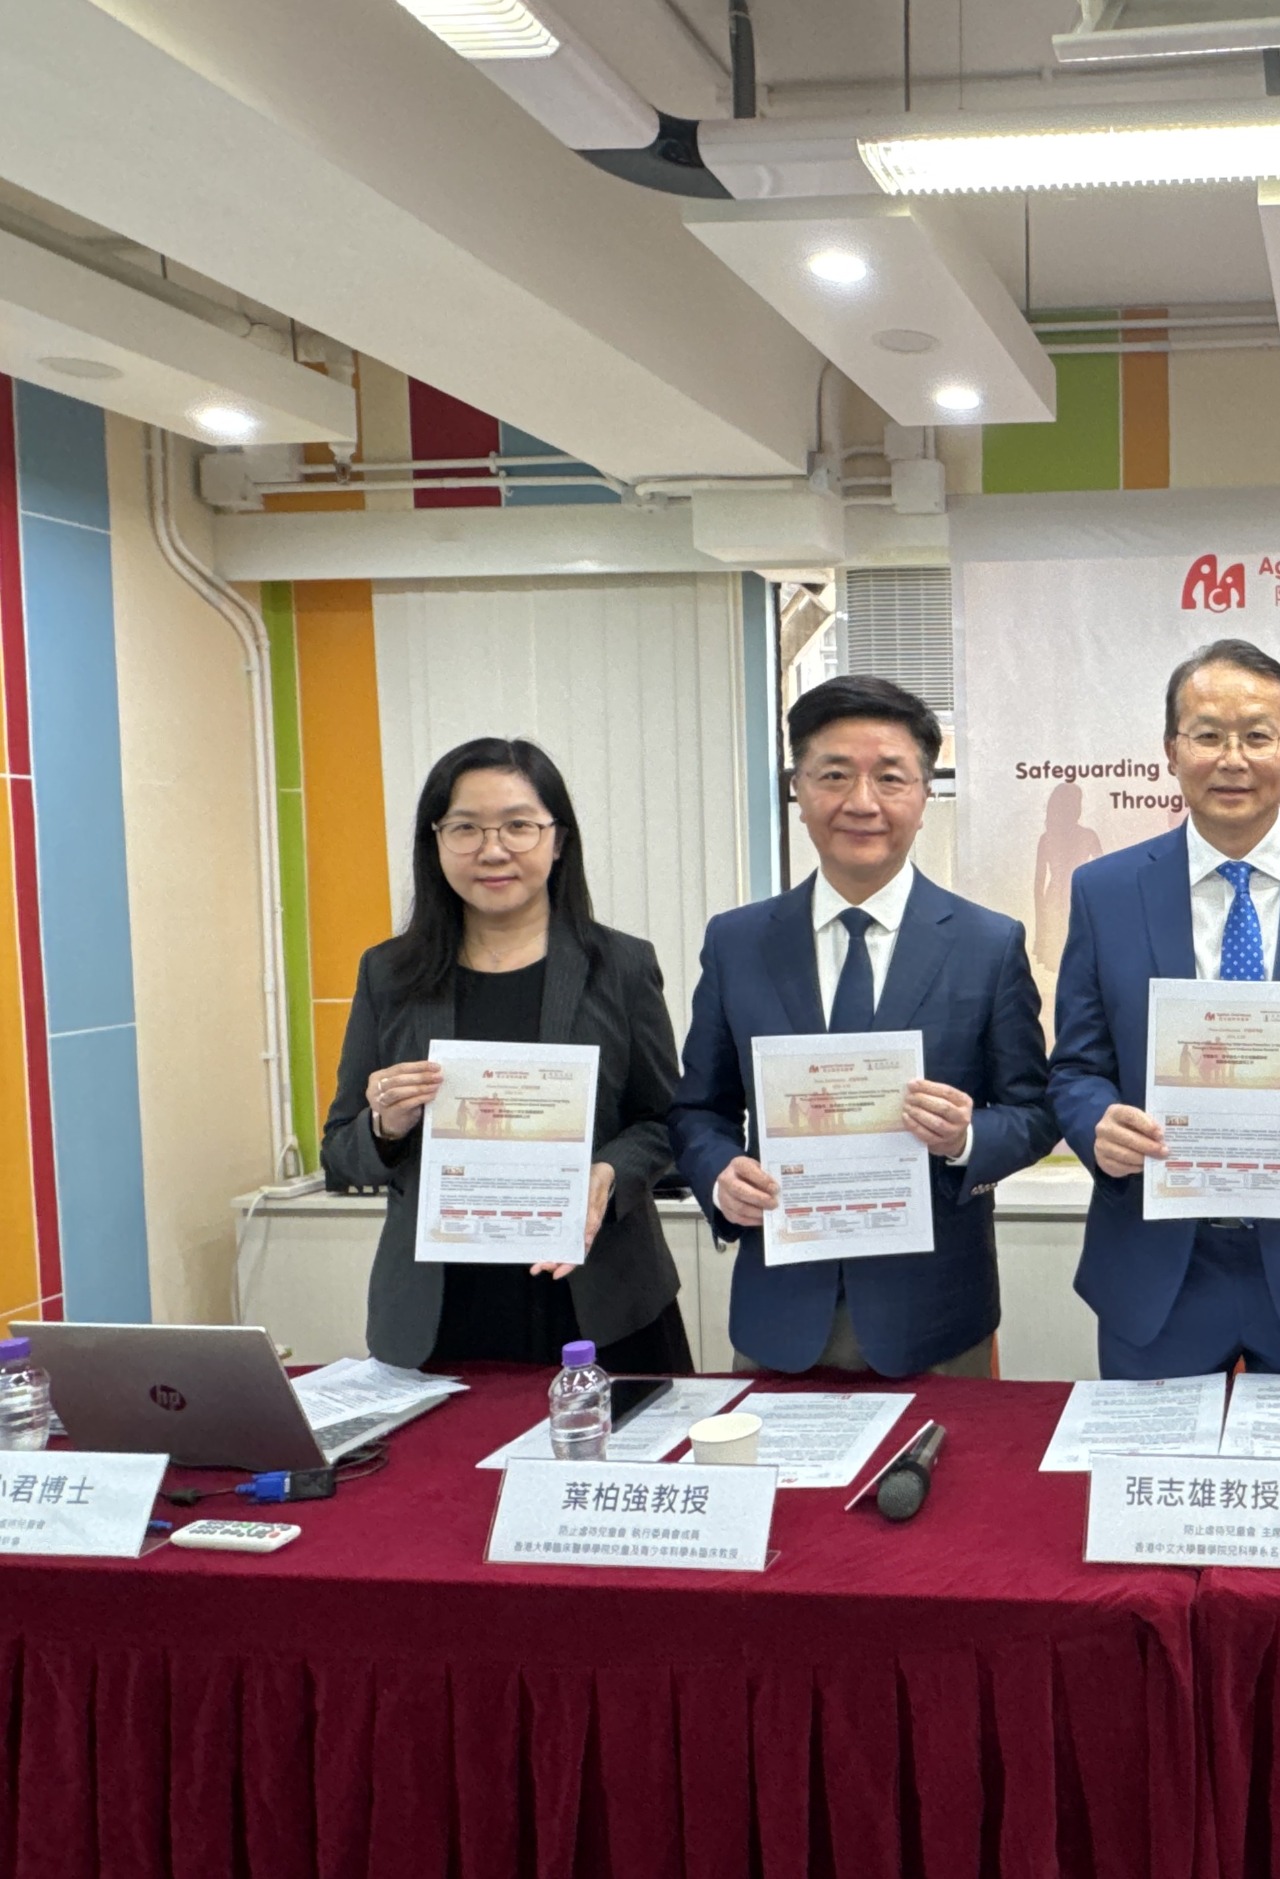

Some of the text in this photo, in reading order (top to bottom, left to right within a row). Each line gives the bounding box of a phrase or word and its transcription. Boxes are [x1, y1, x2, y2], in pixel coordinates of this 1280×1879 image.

[1015, 757, 1161, 783] Safeguarding
[1110, 791, 1190, 814] Throug
[561, 1482, 709, 1515] 葉柏強教授
